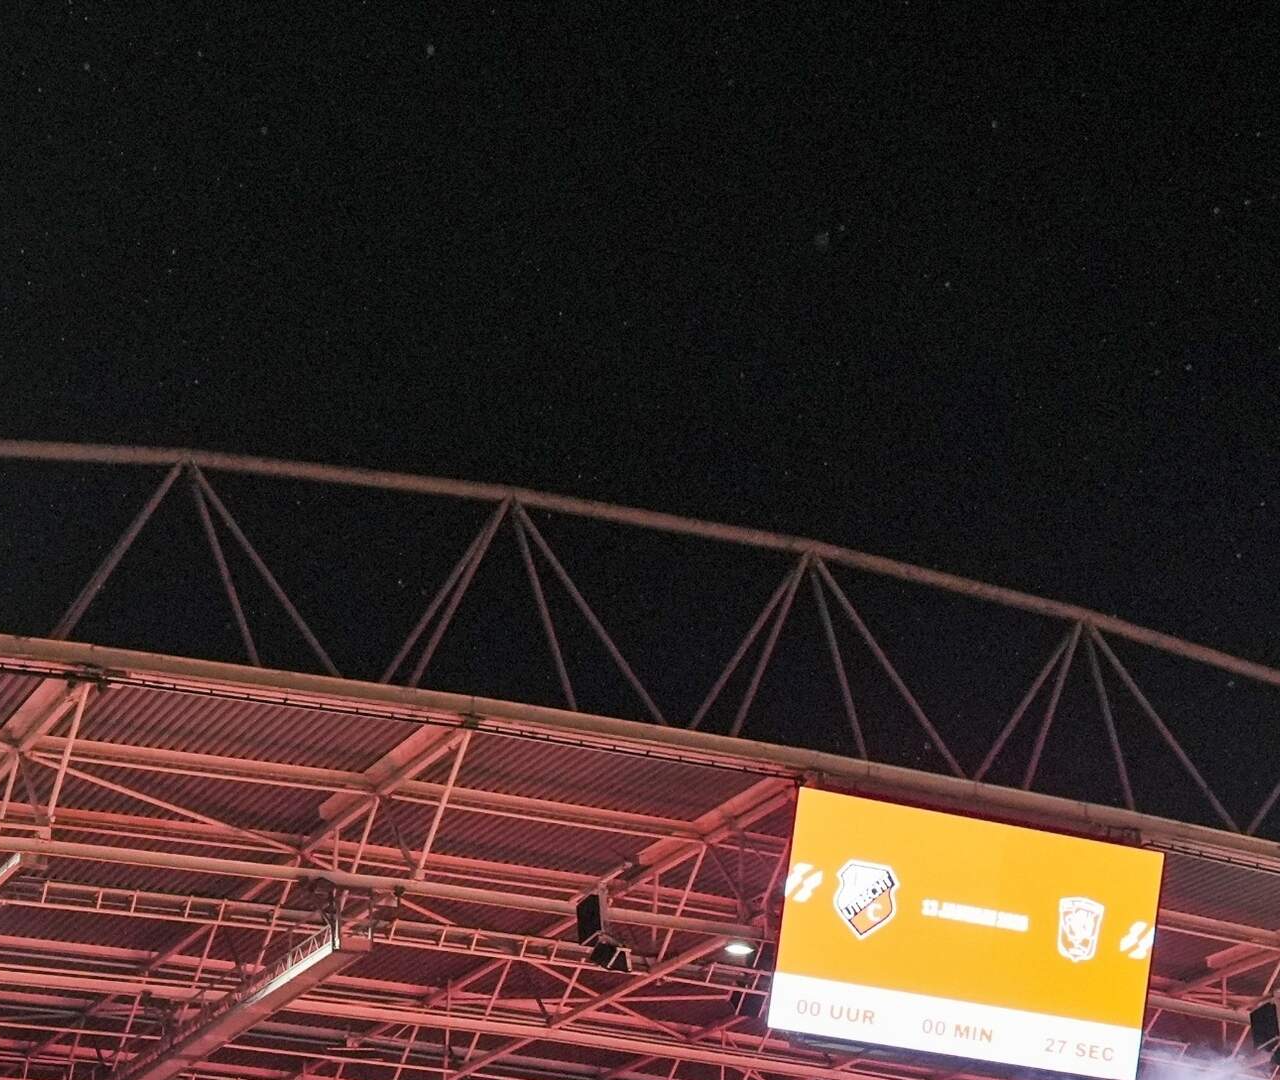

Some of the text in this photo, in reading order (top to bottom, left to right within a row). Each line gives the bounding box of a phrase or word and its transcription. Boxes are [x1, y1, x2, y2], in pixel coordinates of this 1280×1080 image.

[797, 999, 876, 1025] 00 UUR
[922, 1018, 993, 1043] 00 MIN
[1045, 1037, 1115, 1062] 27 SEC
